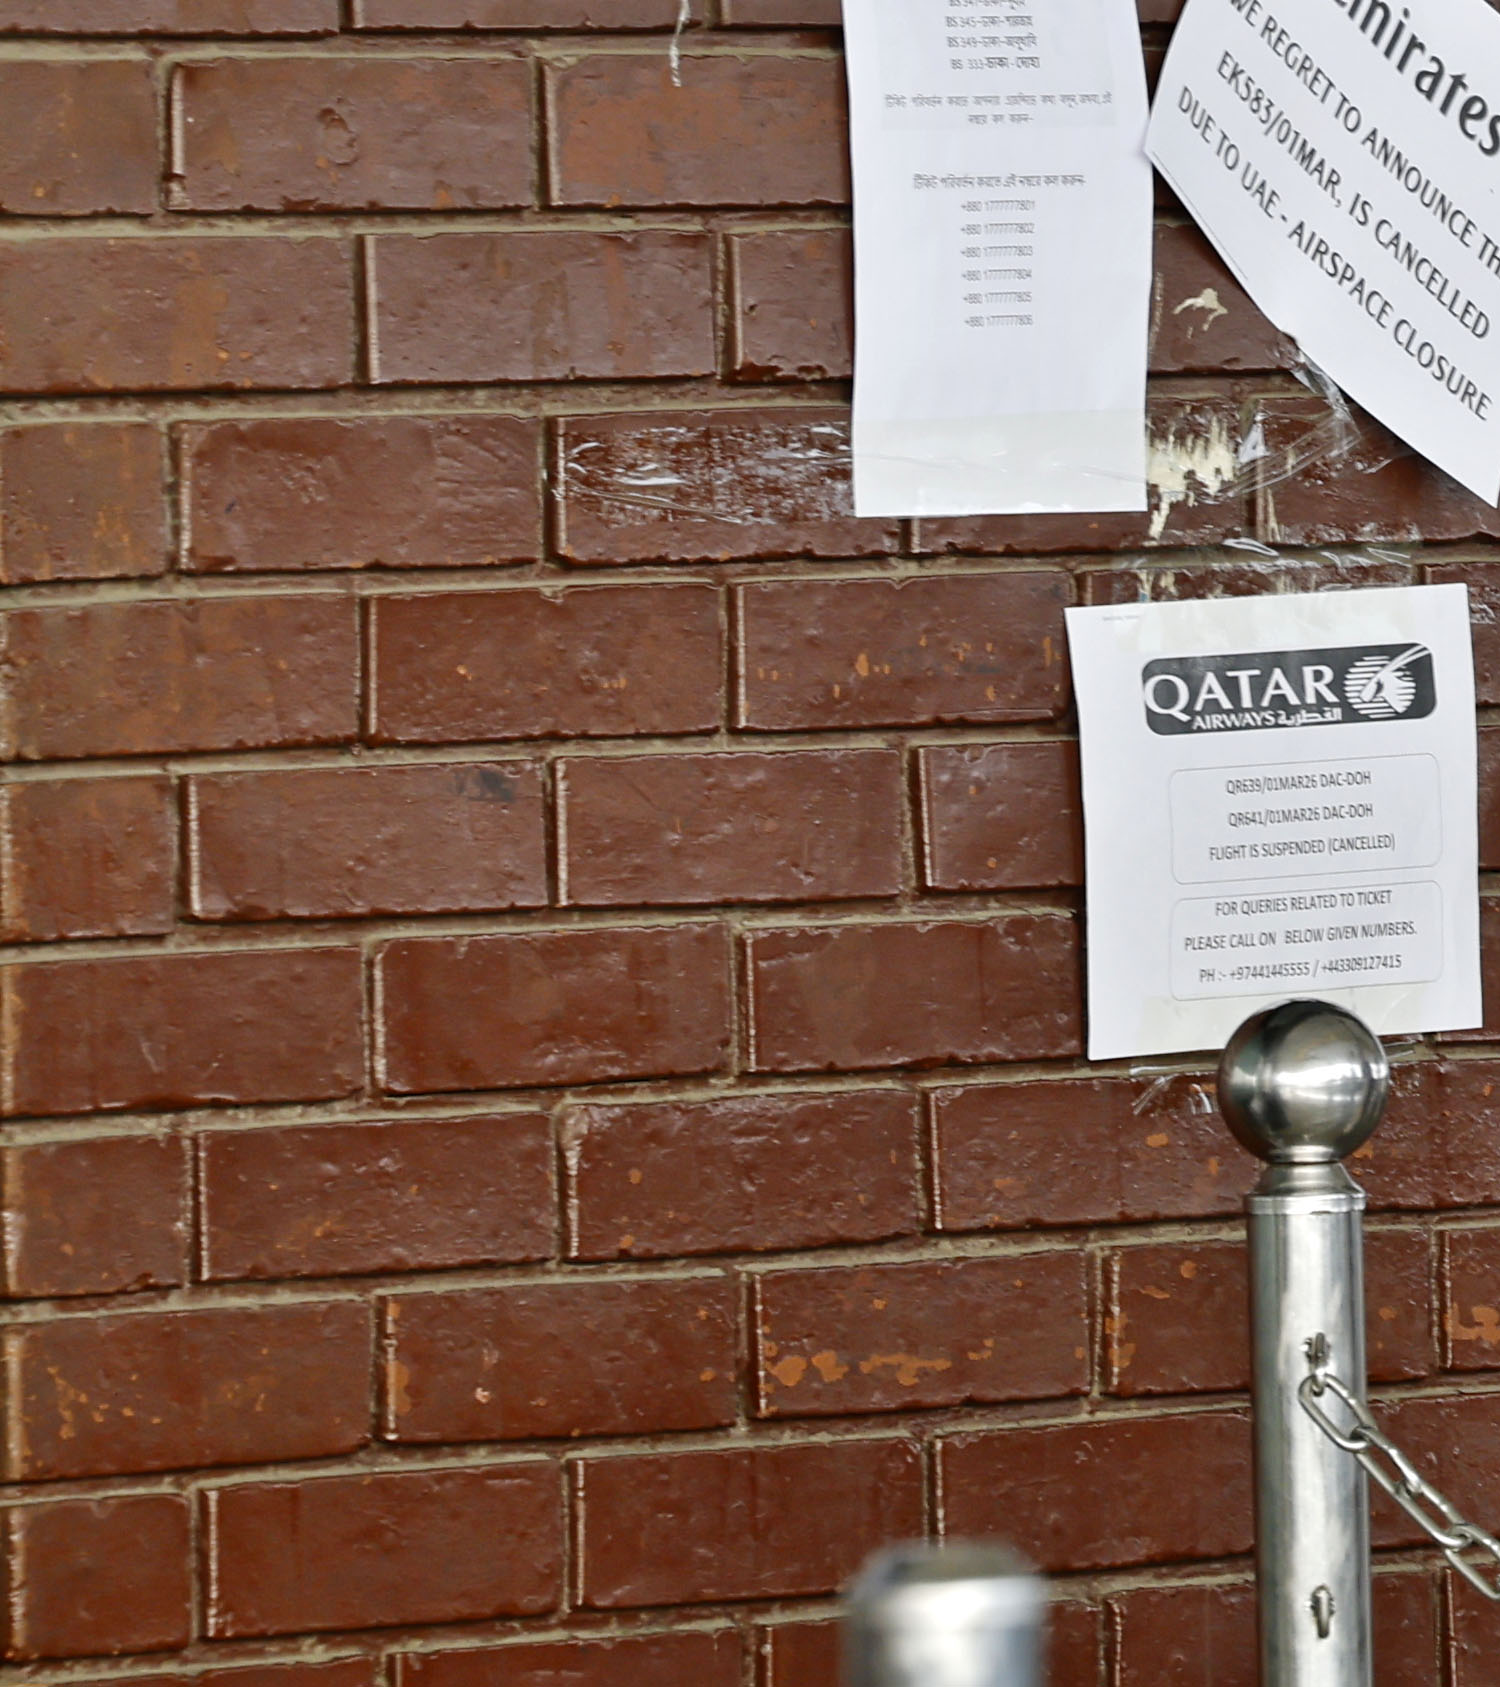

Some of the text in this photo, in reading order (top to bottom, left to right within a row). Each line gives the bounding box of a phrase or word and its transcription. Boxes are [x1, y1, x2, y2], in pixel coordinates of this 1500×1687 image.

[1261, 15, 1336, 104] REGRET
[1334, 92, 1361, 133] TO
[1362, 128, 1478, 247] ANNOUNCE
[1216, 50, 1490, 339] EK583/01MAR, IS CANCELLED
[1178, 86, 1492, 421] DUE TO UAE AIRSPACE CLOSURE
[1144, 664, 1340, 722] QATAR
[1192, 712, 1276, 730] AIRWAYS
[1277, 707, 1342, 728] القطرية
[1227, 771, 1371, 795] QR639/01MAR26 DAC-DOH
[1229, 804, 1373, 827] QR641/01MAR26 DAC-DOH
[1209, 834, 1395, 860] FLIGHT IS SUSPENDED (CANCELLED)
[1216, 890, 1392, 916] FOR QUERIES RELATED TO TICKET
[1185, 921, 1416, 950] PLEASE CALL ON BELOW GIVEN NUMBERS.
[1200, 969, 1215, 982] PH
